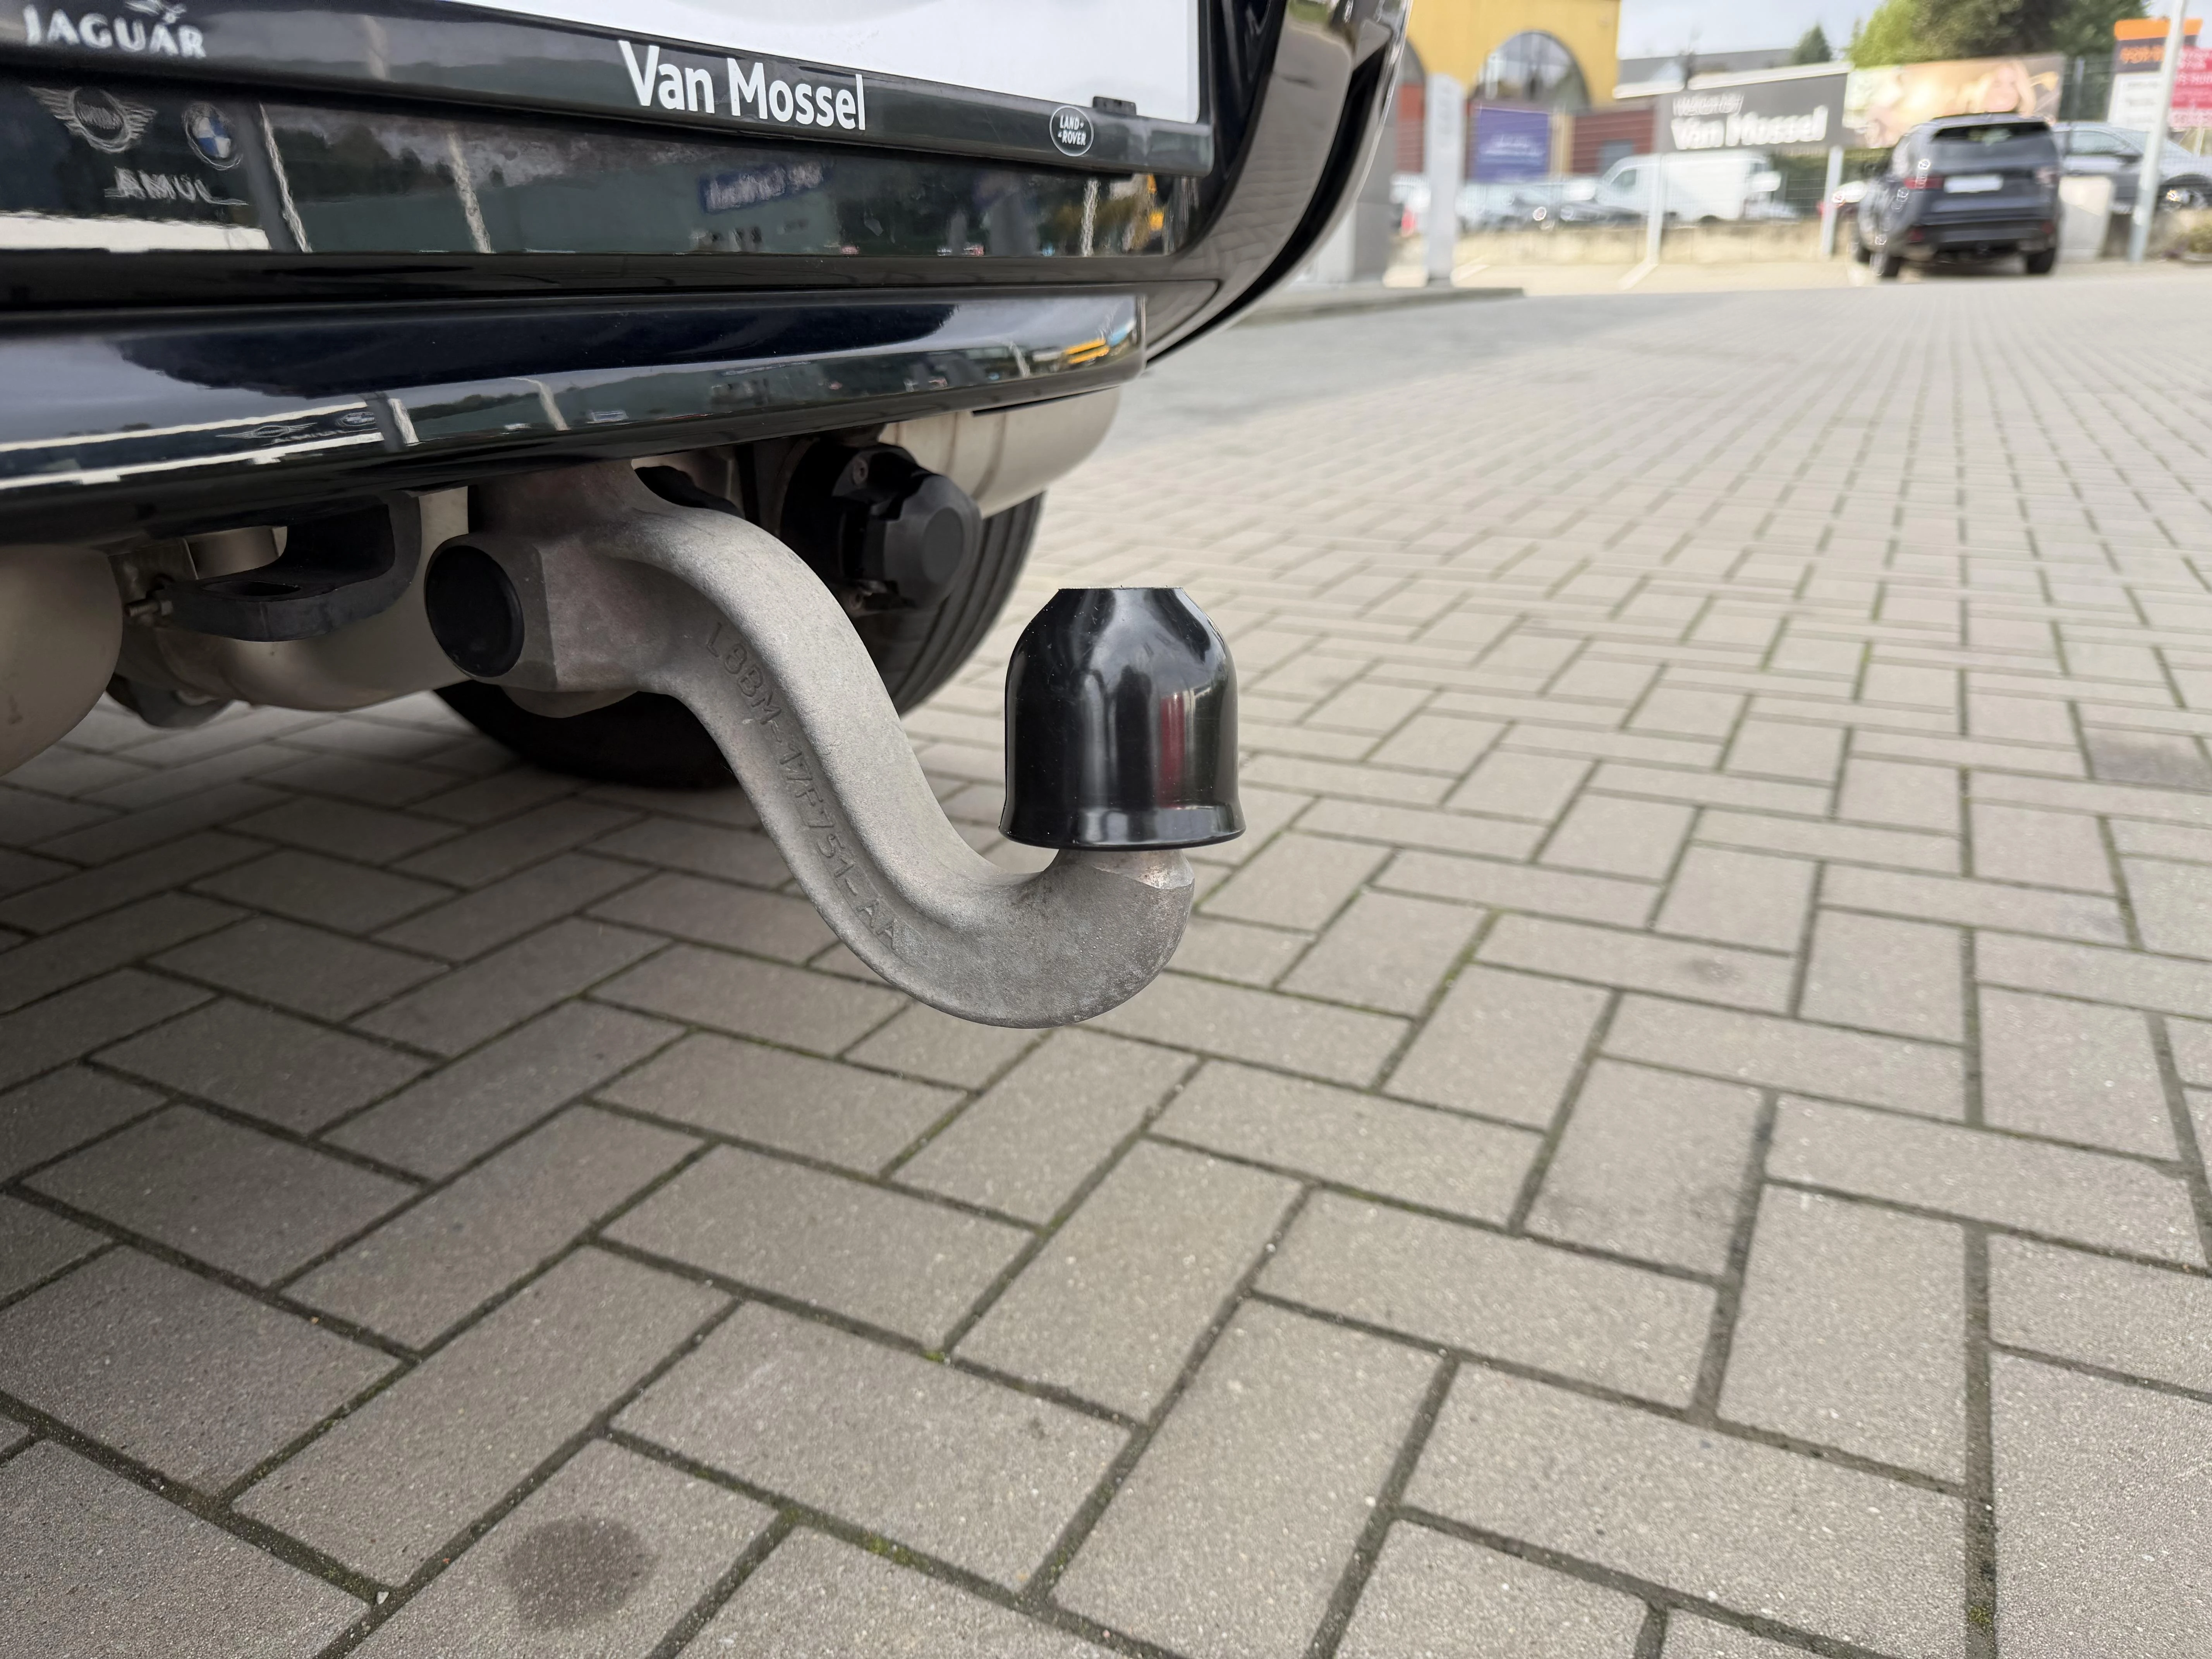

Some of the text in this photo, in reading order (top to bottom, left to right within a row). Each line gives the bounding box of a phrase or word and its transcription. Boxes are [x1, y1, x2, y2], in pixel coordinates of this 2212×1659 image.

[23, 4, 206, 59] JAGUAR
[618, 40, 866, 130] Van Mossel
[1060, 115, 1080, 130] LAND
[1062, 130, 1086, 146] ROVER
